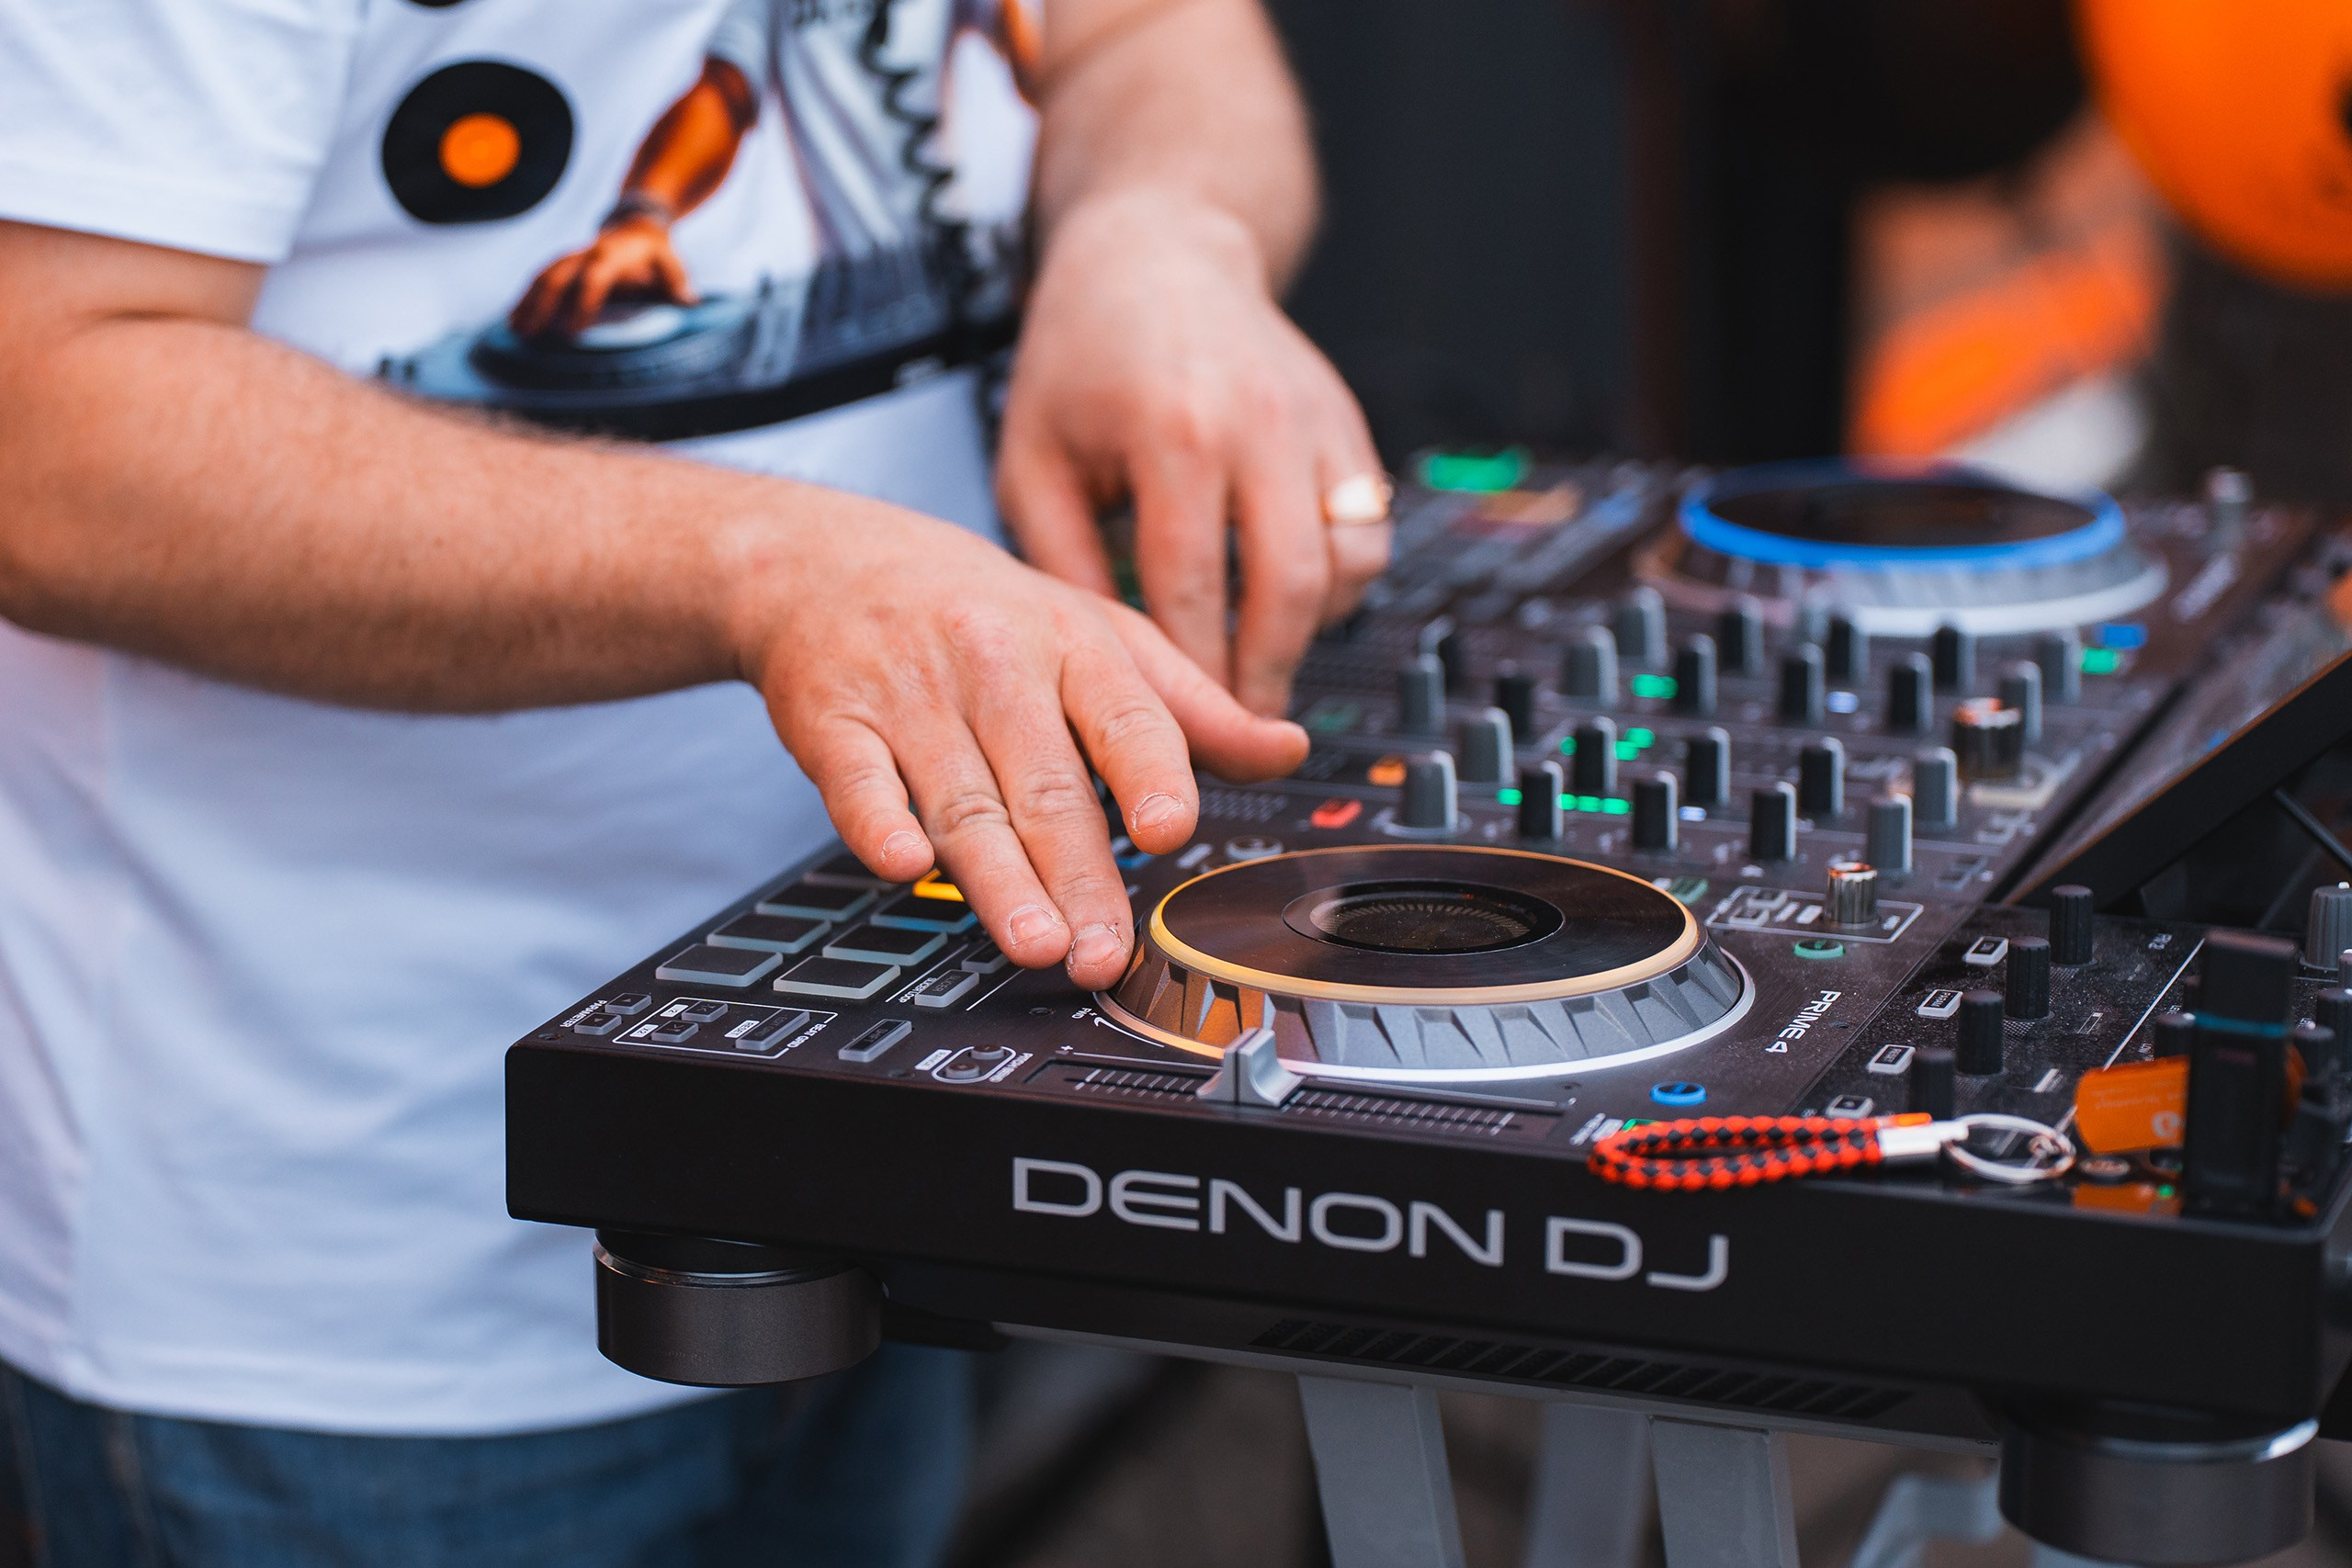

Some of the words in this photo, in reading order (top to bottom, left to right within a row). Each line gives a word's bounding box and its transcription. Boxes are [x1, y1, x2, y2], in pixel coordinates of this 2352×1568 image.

[899, 989, 920, 1003] LOOP
[1931, 992, 1951, 1008] PARAM
[560, 999, 607, 1028] PARAMETER
[1071, 1007, 1092, 1019] FWD
[1778, 990, 1842, 1040] PRIME
[804, 1023, 827, 1037] BEAT
[864, 1028, 888, 1043] SHIFT
[786, 1035, 808, 1048] GRID
[1765, 1041, 1788, 1054] 4
[1012, 1156, 1505, 1267] DENON
[1546, 1216, 1730, 1292] DJ
